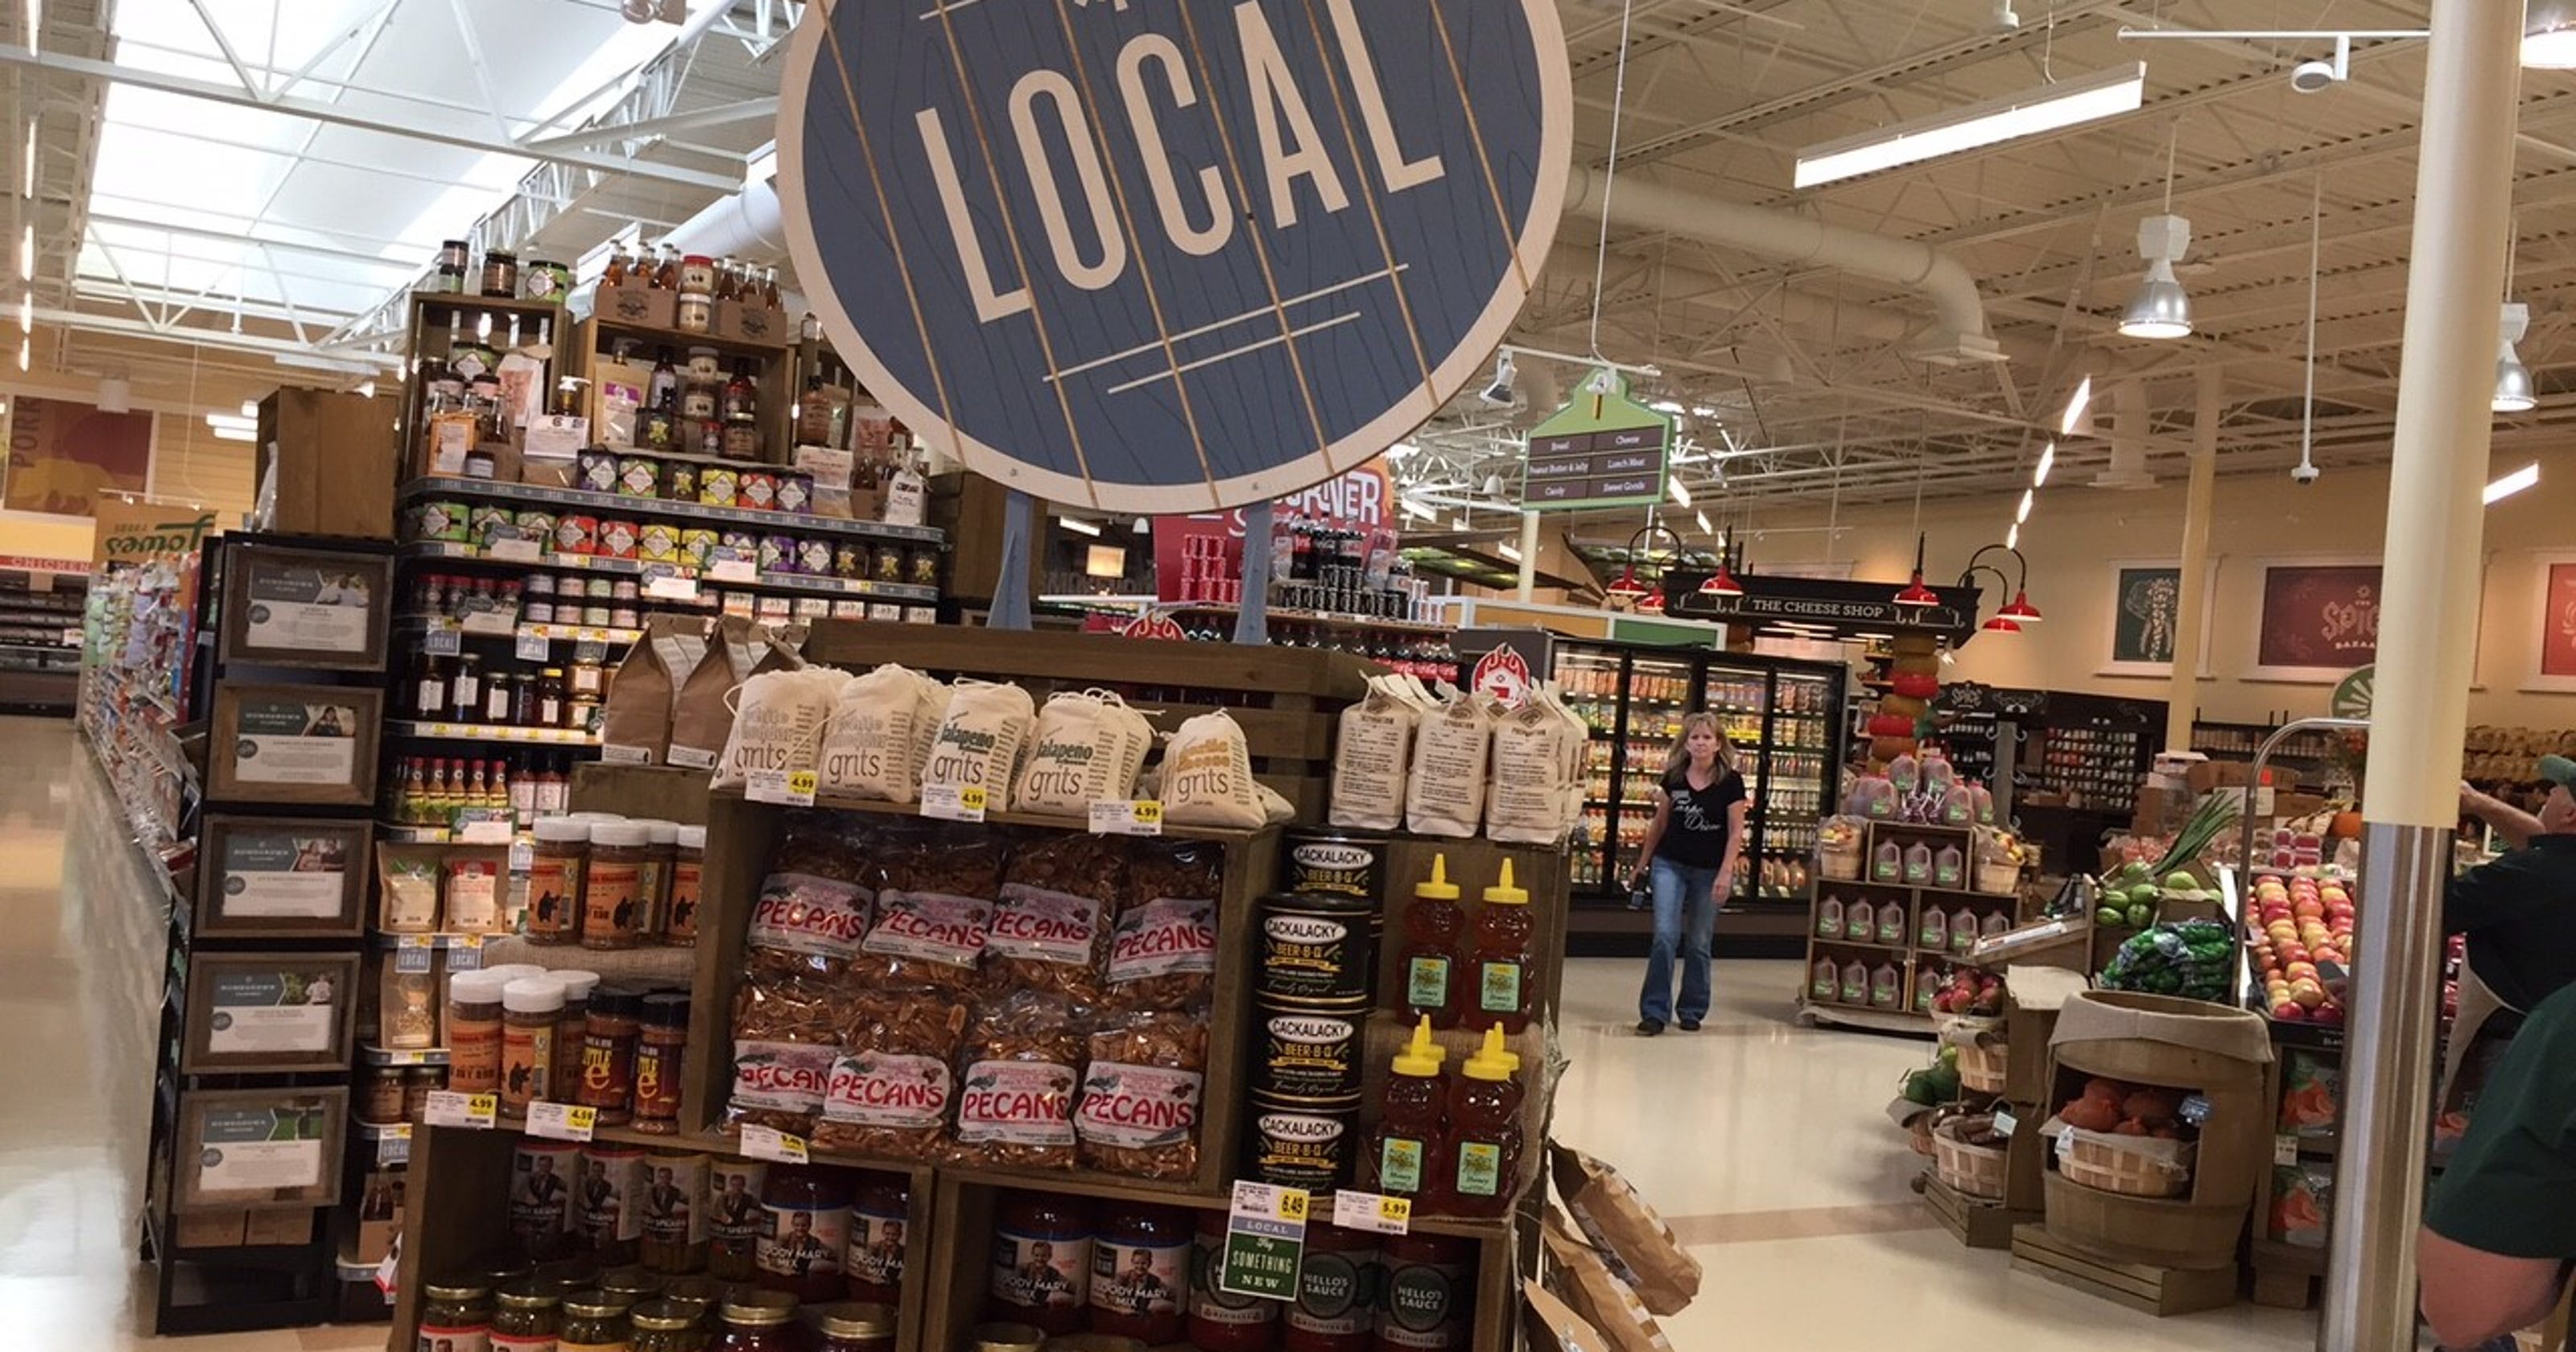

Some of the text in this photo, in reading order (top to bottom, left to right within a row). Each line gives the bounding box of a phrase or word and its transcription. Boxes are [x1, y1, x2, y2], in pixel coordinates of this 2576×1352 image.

[915, 0, 1445, 323] LOCAL
[12, 395, 41, 468] PORK
[1752, 599, 1885, 618] THE CHEESE SHOP
[2322, 601, 2380, 641] SPIC
[2335, 640, 2376, 650] BAZAA
[735, 742, 788, 776] grits
[828, 746, 881, 784] grits
[933, 752, 984, 785] grits
[791, 777, 814, 789] 4.99
[1030, 765, 1082, 802] grits
[1177, 768, 1228, 803] grits
[961, 793, 984, 804] 4.99
[1133, 806, 1158, 817] 4.99
[1298, 848, 1366, 865] CACKALACKY
[756, 900, 865, 940] PECANS
[878, 909, 987, 947] PECANS
[1267, 919, 1338, 938] CACKALACKY
[1114, 925, 1216, 958] PECANS
[1273, 1020, 1347, 1037] CACKALACKY
[741, 1066, 830, 1091] PECAN
[828, 1074, 944, 1108] PECANS
[469, 1098, 492, 1109] 4.99
[964, 1092, 1069, 1120] PECANS
[1081, 1093, 1192, 1127] PECANS
[1262, 1117, 1336, 1136] CACKALACKY
[1281, 1193, 1304, 1215] 6.49
[1382, 1202, 1407, 1215] 5.99
[1247, 1221, 1288, 1235] LOCAL
[1232, 1250, 1293, 1275] SOMETHING
[1241, 1275, 1280, 1289] NEW
[1306, 1284, 1345, 1297] SAUCE
[1399, 1297, 1440, 1311] SAUCE
